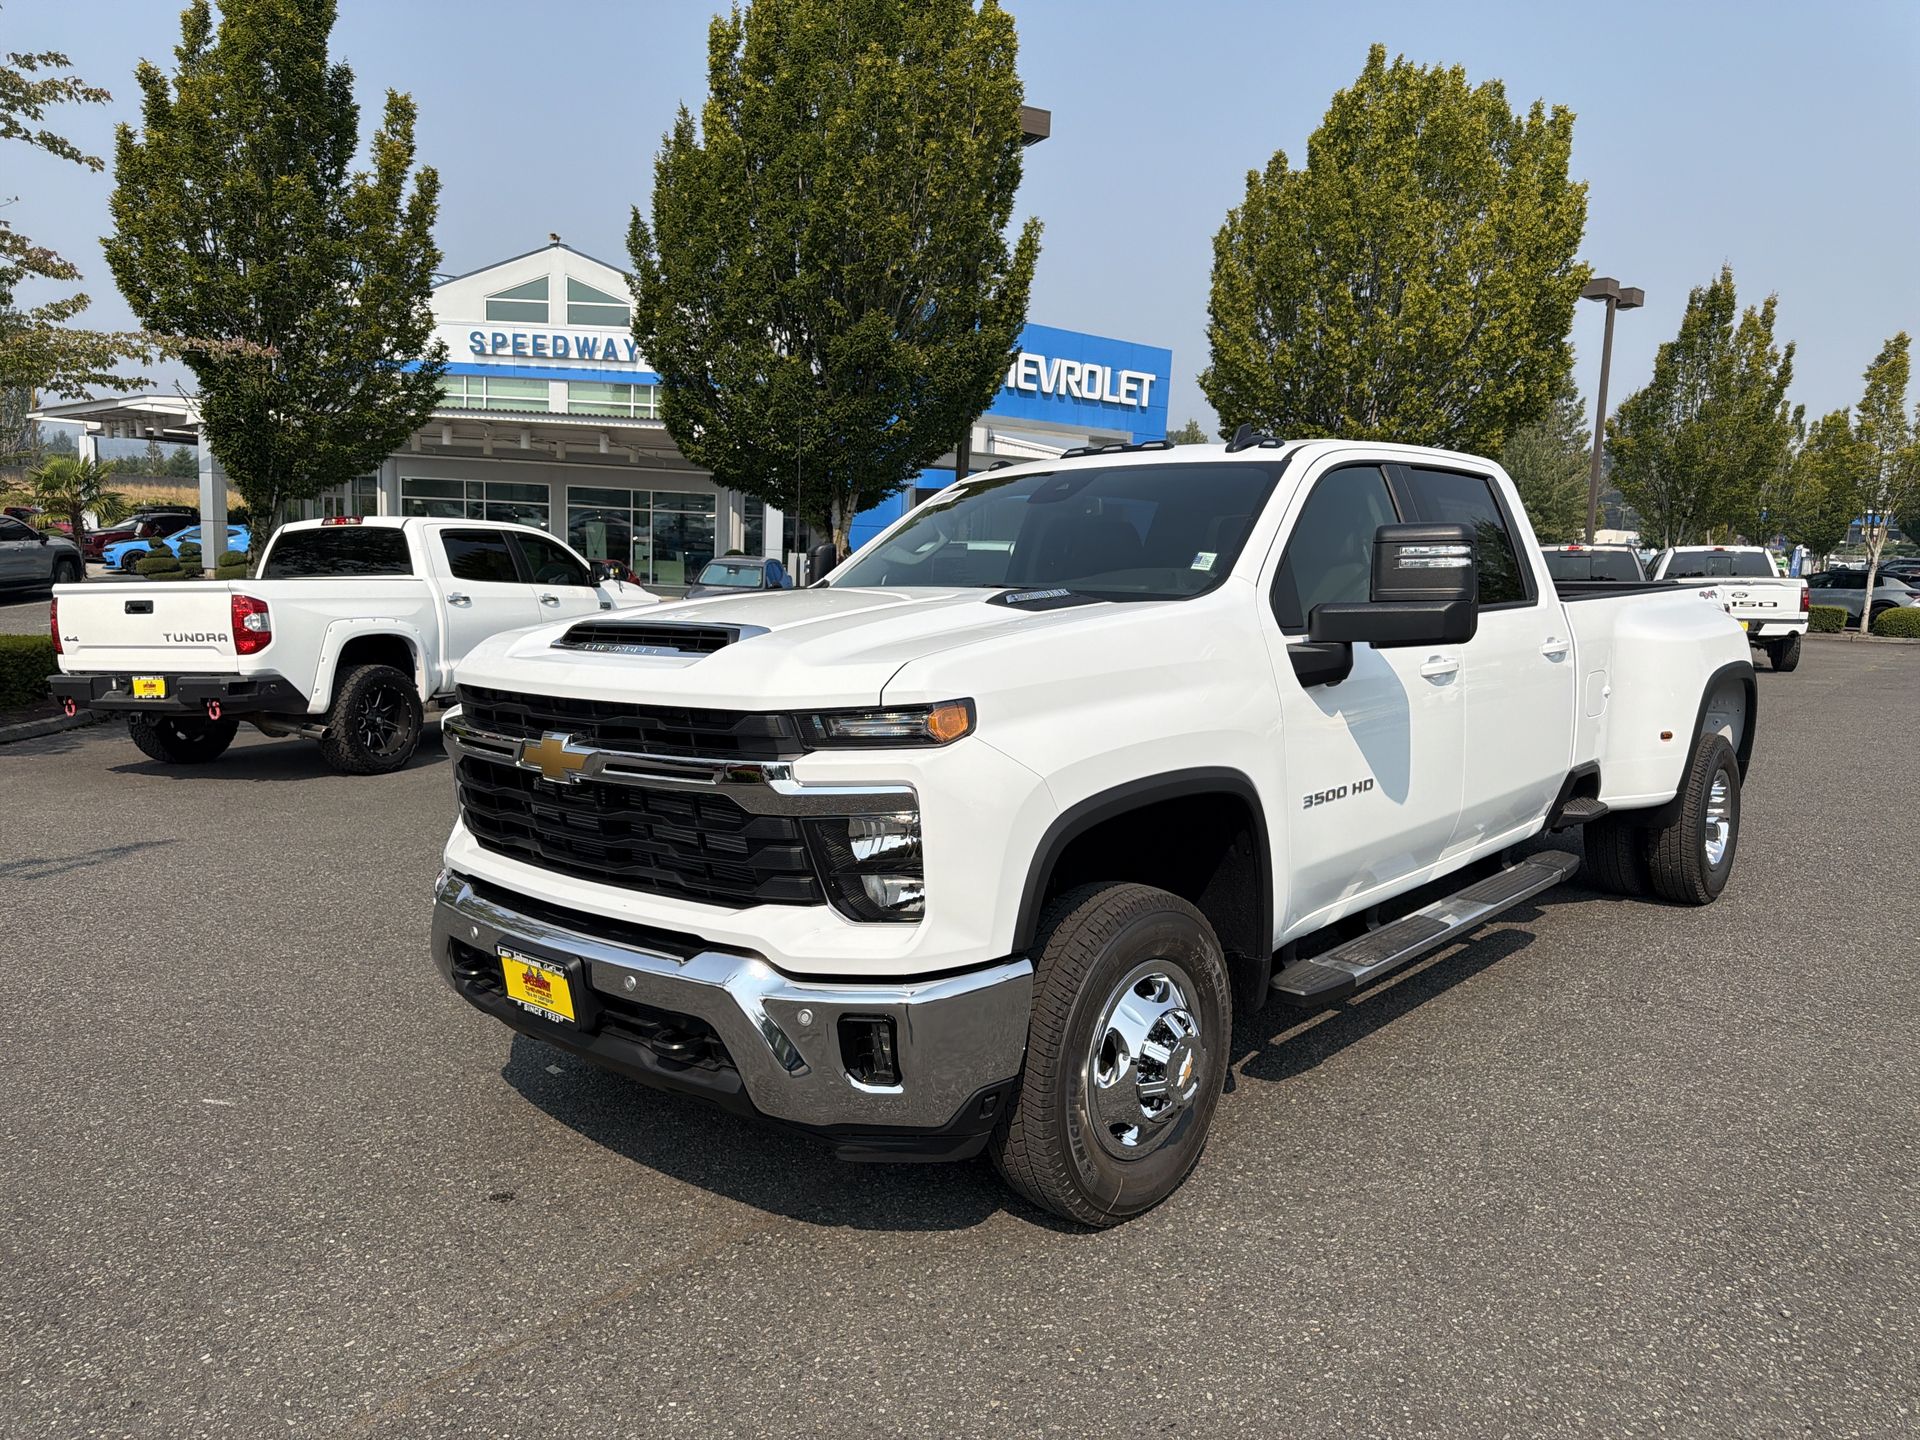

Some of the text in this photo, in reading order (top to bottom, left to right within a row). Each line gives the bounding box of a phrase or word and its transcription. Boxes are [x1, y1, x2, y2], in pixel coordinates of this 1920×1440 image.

[470, 331, 637, 362] SPEEDWAY
[1007, 352, 1157, 407] EVROLET
[163, 633, 228, 643] TUNDRA
[1303, 778, 1374, 810] 3500 HD
[523, 1003, 543, 1017] SINCE
